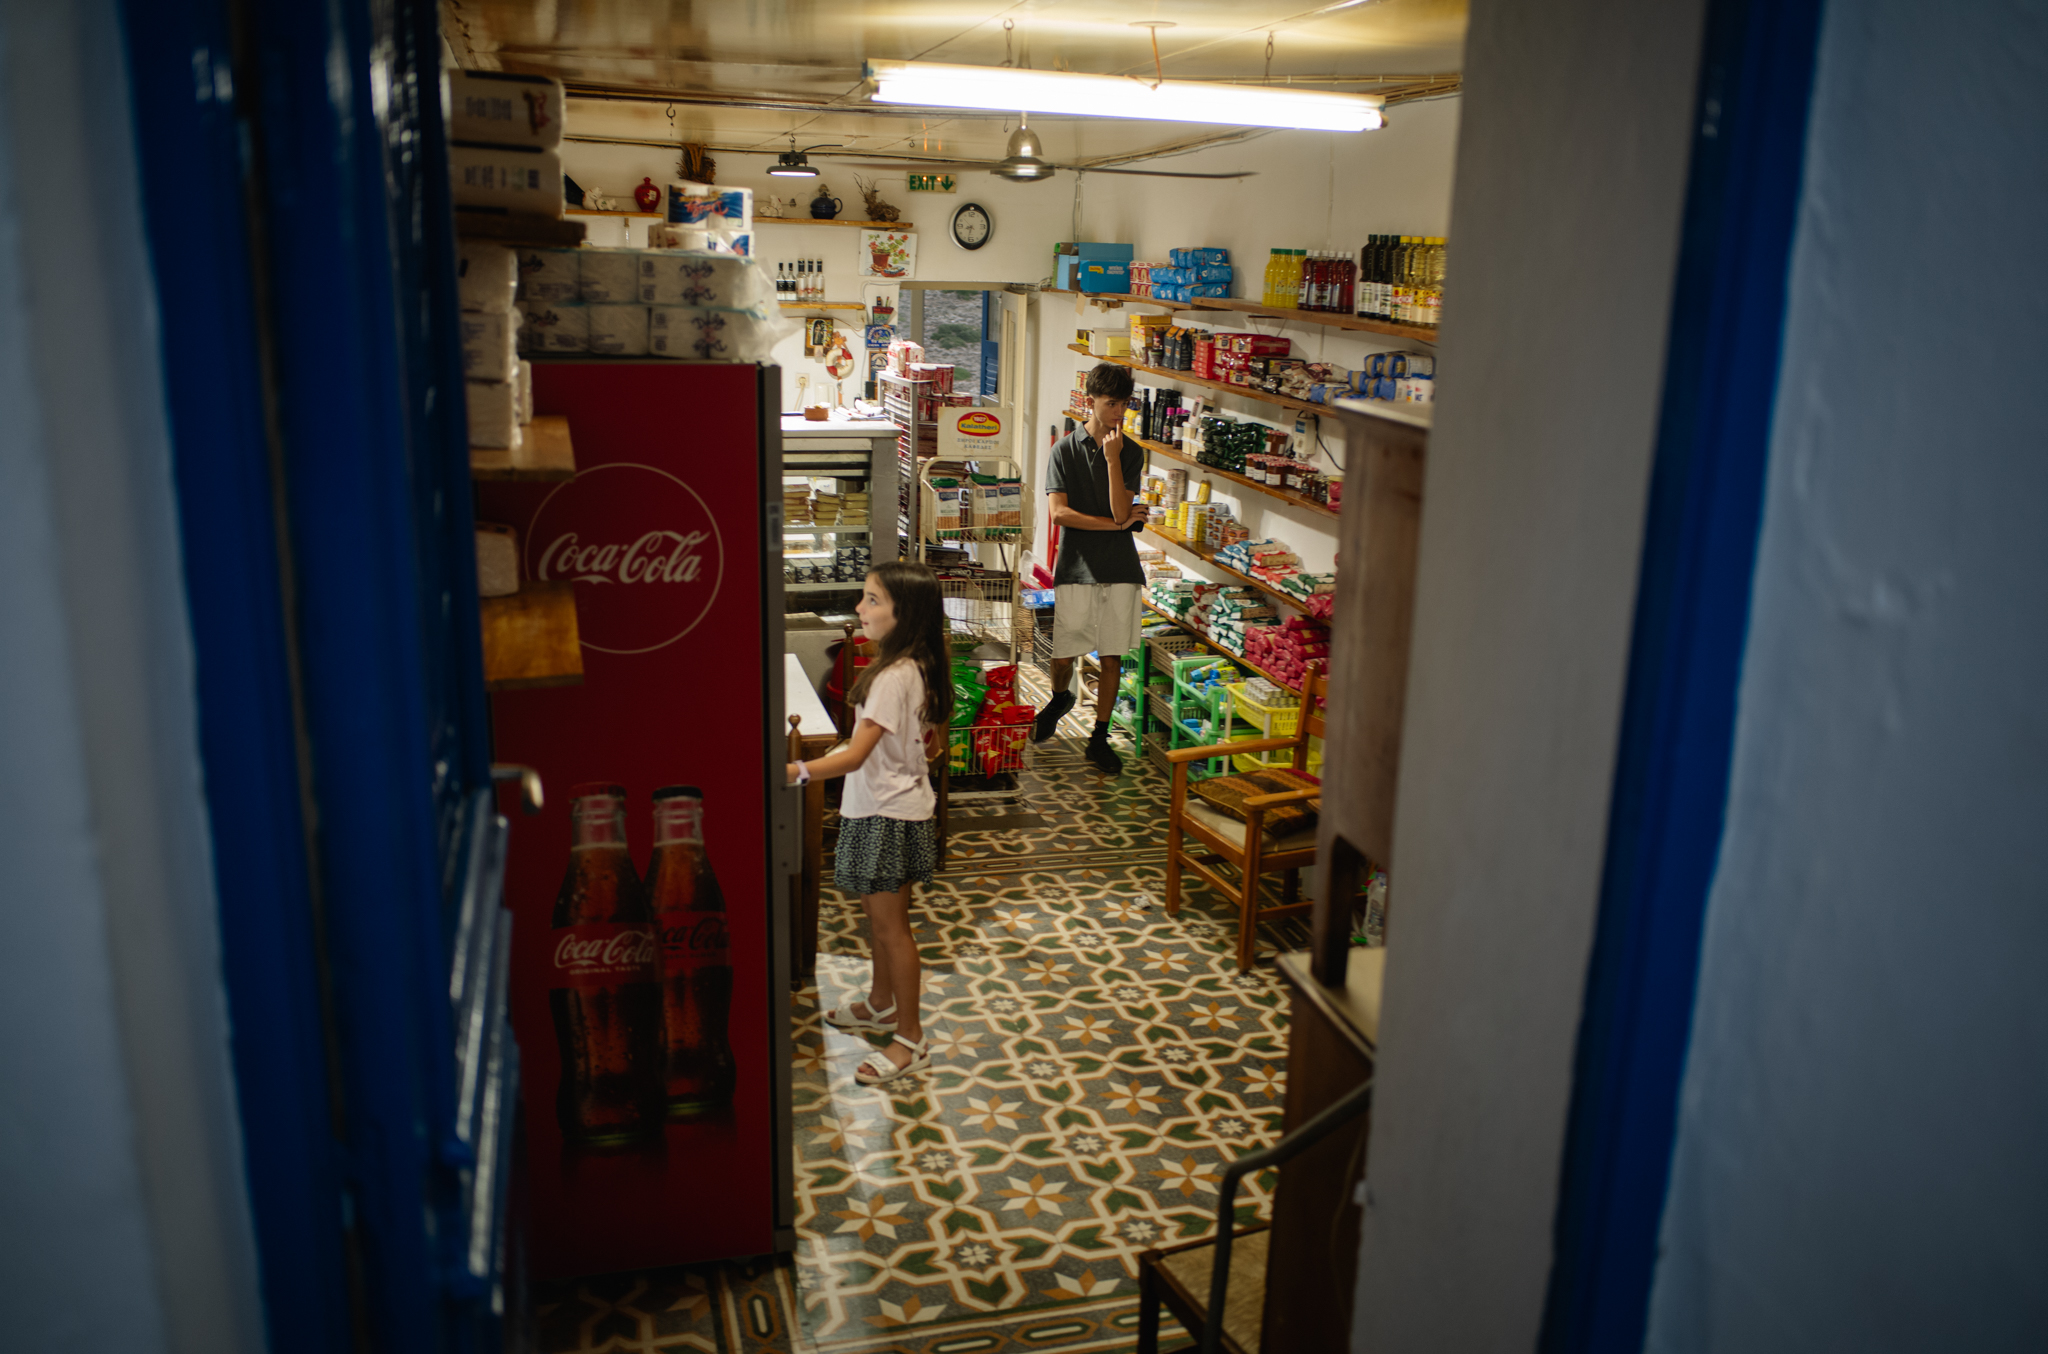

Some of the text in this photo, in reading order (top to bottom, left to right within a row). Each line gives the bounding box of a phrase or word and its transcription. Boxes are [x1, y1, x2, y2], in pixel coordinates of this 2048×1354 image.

[909, 175, 936, 190] EXIT
[538, 530, 710, 584] Coca-Cola
[554, 930, 656, 969] Coca-Cola
[569, 968, 612, 976] ORIGINAL
